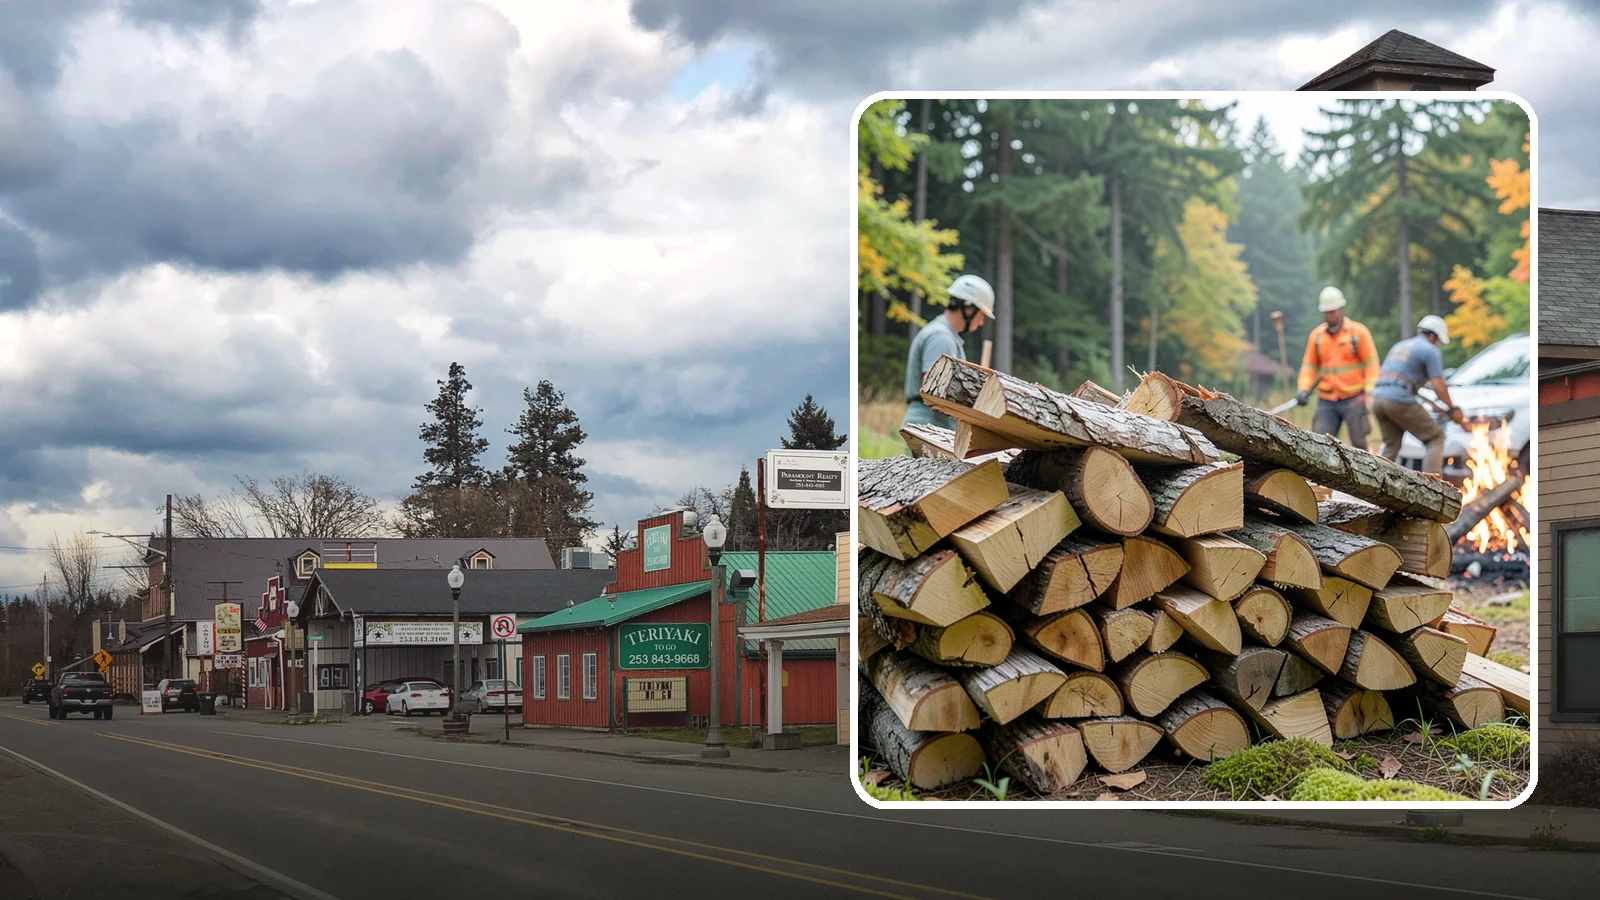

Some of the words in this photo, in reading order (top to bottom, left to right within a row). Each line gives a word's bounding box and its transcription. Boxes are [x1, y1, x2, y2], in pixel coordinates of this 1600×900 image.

[817, 472, 838, 480] REALTY
[625, 627, 702, 646] TERIYAKI
[629, 654, 648, 664] 253
[651, 654, 700, 664] 843-9668
[639, 681, 672, 690] TERIYAKI
